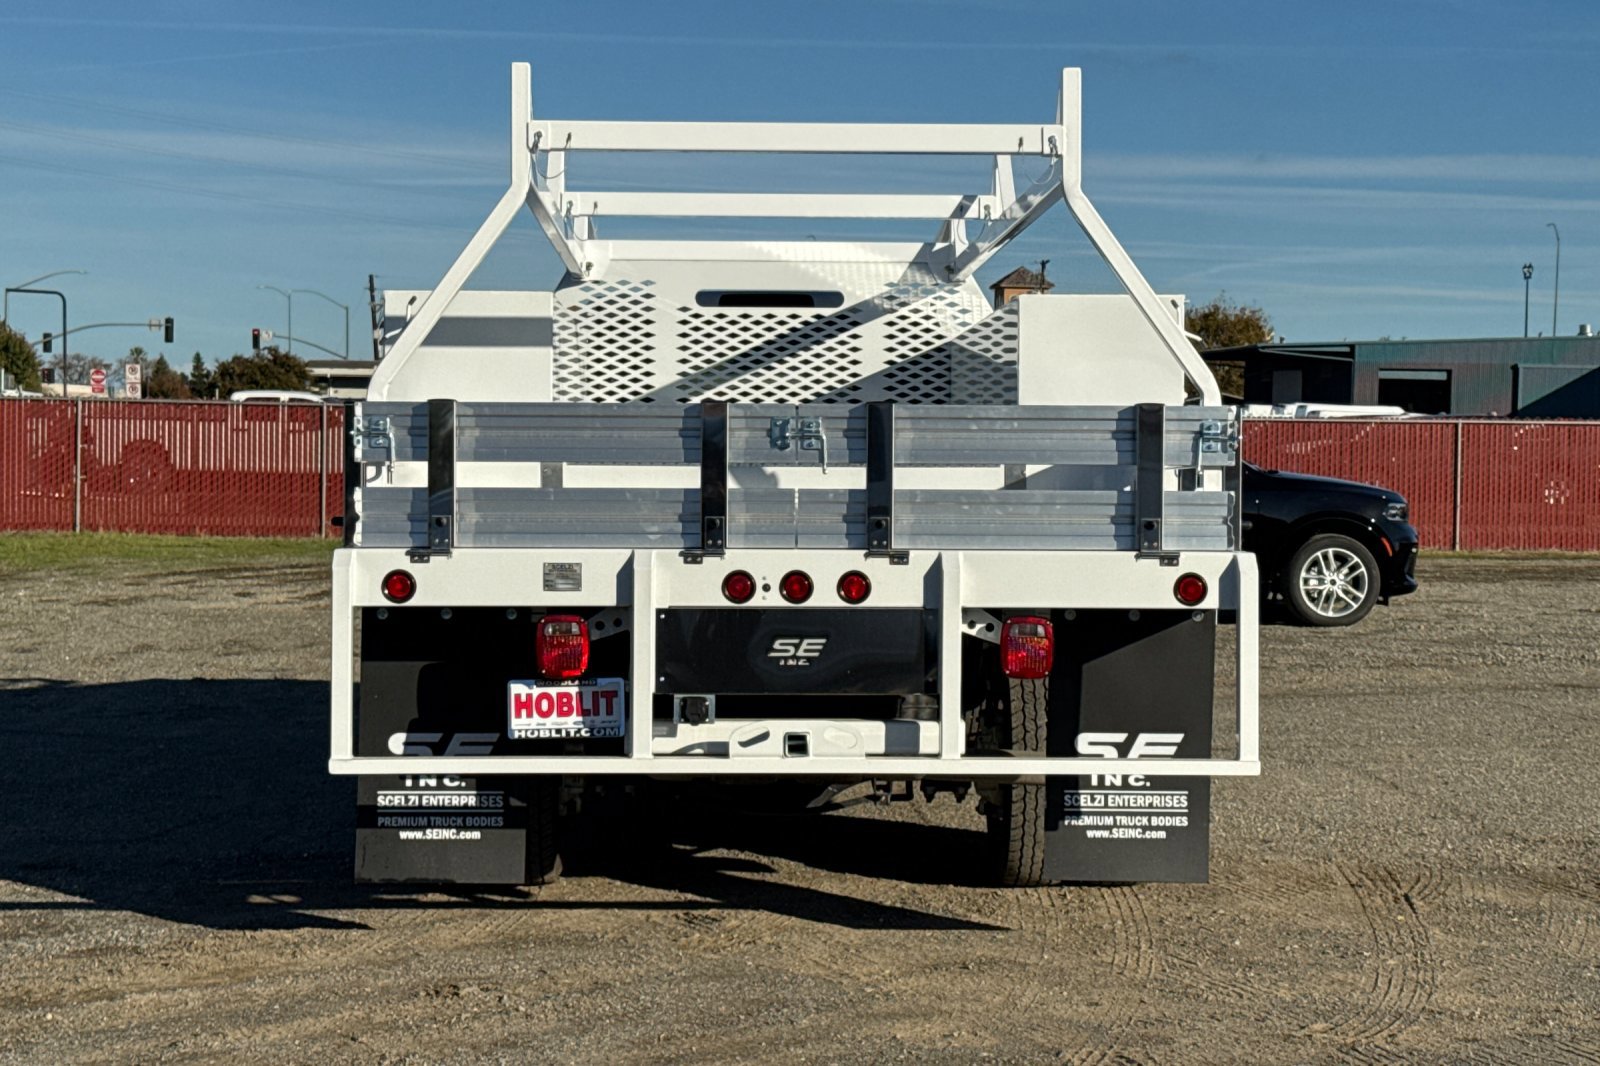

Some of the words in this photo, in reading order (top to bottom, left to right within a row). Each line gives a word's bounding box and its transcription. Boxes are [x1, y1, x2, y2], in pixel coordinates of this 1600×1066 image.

[767, 638, 828, 657] SE
[513, 690, 618, 719] HOBLIT
[514, 727, 619, 739] HOBLIT.COM
[377, 795, 419, 808] SCELZI
[421, 795, 504, 808] ENTERPRISES
[1063, 794, 1105, 807] SCELZI
[1107, 794, 1188, 808] ENTERPRISES
[377, 816, 428, 828] PREMIUM
[429, 816, 464, 828] TRUCK
[465, 816, 504, 828] BODIES
[1064, 815, 1114, 827] PREMIUM
[1116, 815, 1150, 827] TRUCK
[1151, 815, 1189, 827] BODIES
[399, 828, 482, 840] www.SEINC.com
[1086, 827, 1167, 839] www.SEINC.com
